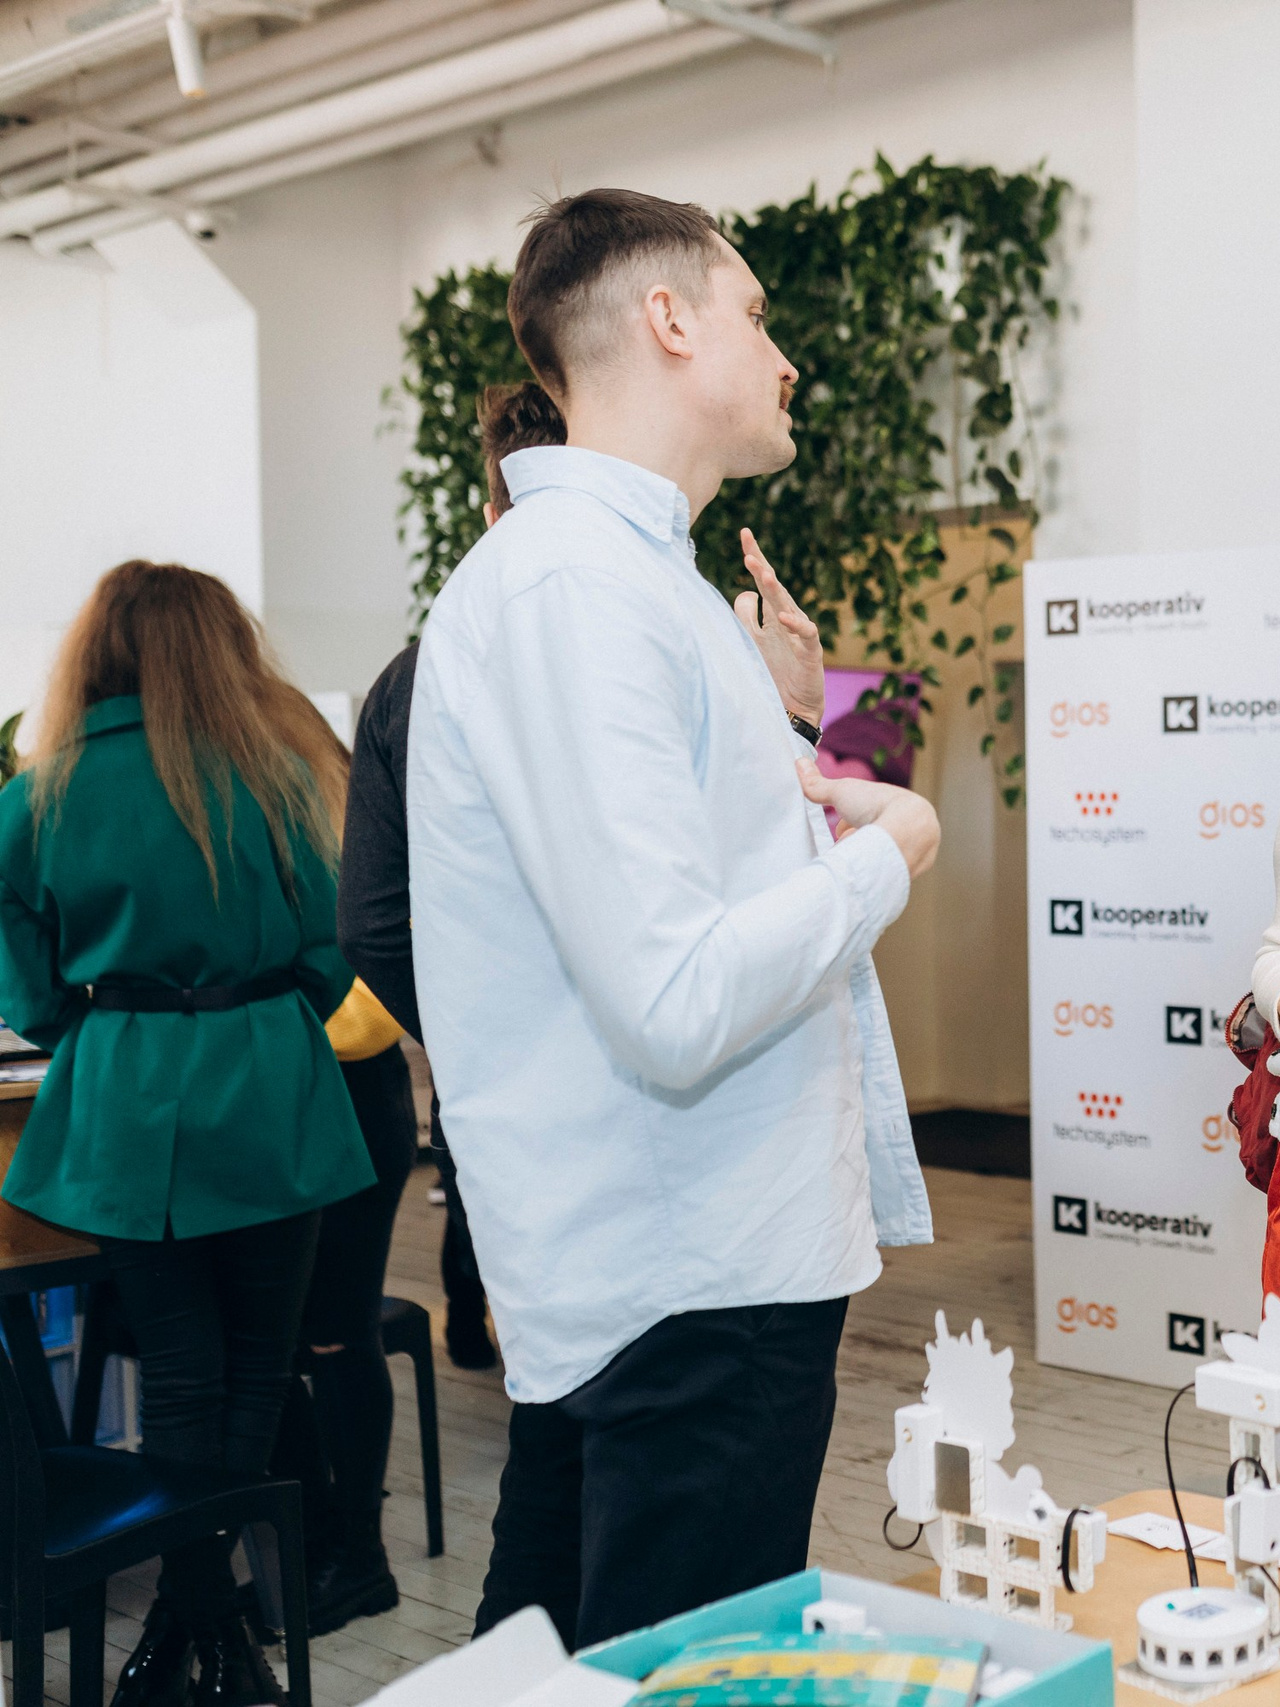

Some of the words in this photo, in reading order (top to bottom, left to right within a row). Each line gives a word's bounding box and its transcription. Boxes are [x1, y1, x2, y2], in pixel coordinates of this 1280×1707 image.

[1087, 591, 1205, 622] kooperativ
[1199, 801, 1266, 839] gios
[1091, 902, 1208, 929] kooperativ
[1053, 1000, 1114, 1037] gios
[1095, 1201, 1213, 1237] kooperativ
[1057, 1297, 1118, 1334] gios
